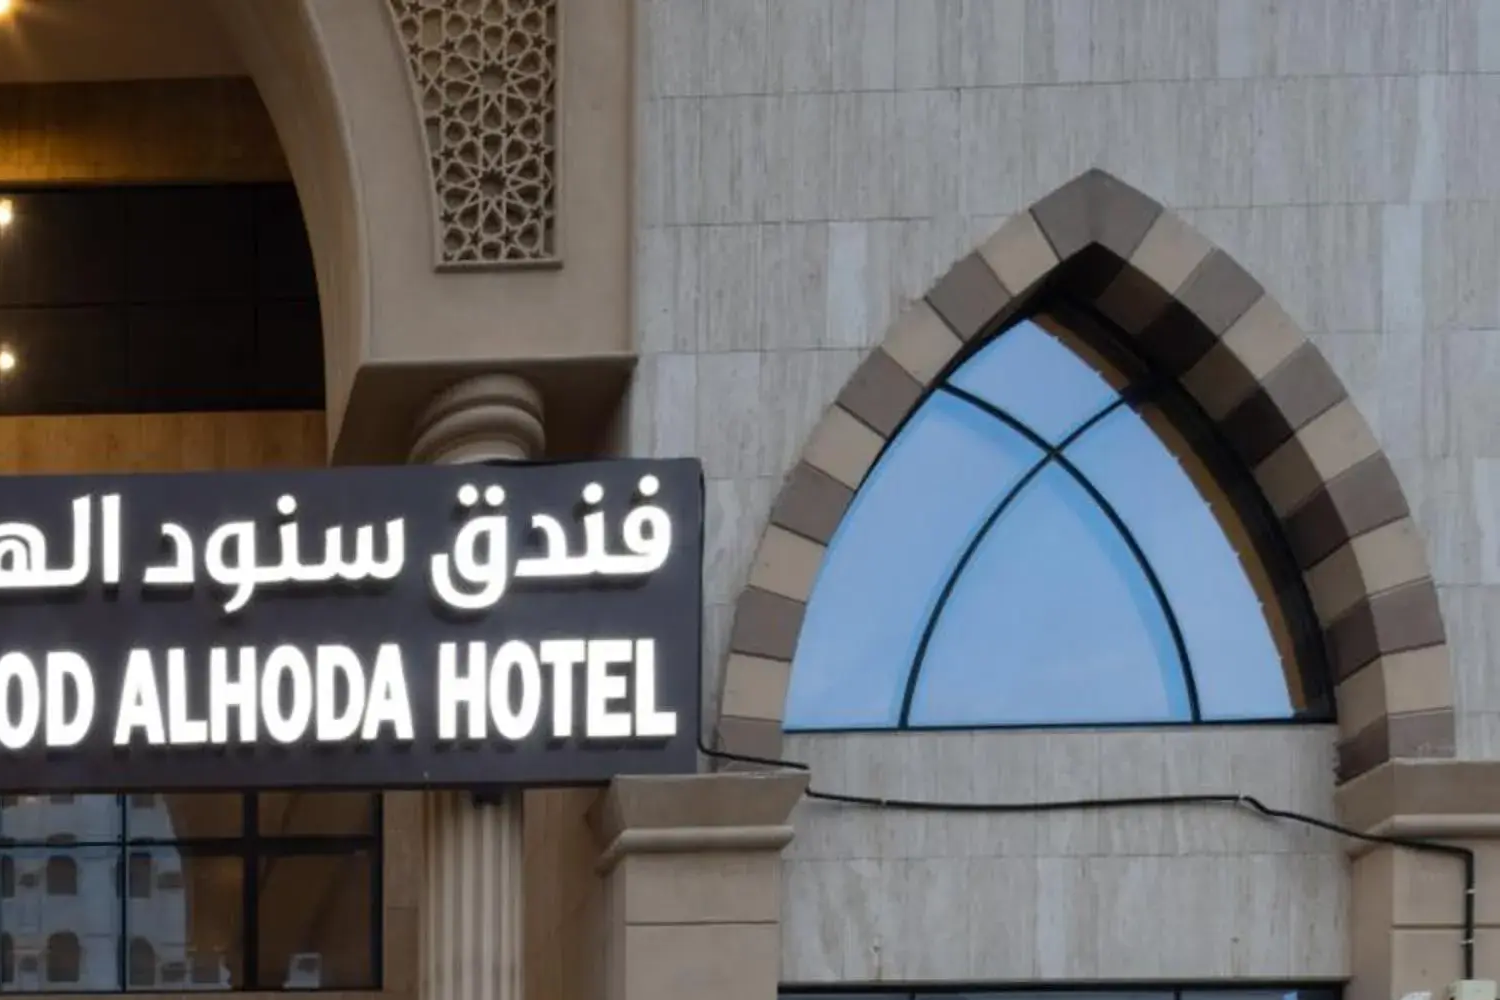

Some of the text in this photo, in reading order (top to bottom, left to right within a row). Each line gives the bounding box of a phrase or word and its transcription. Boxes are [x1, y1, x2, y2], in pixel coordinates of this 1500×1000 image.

[143, 494, 405, 613] سنود
[430, 474, 673, 609] فندق
[113, 643, 415, 746] ALHODA
[438, 637, 677, 741] HOTEL
